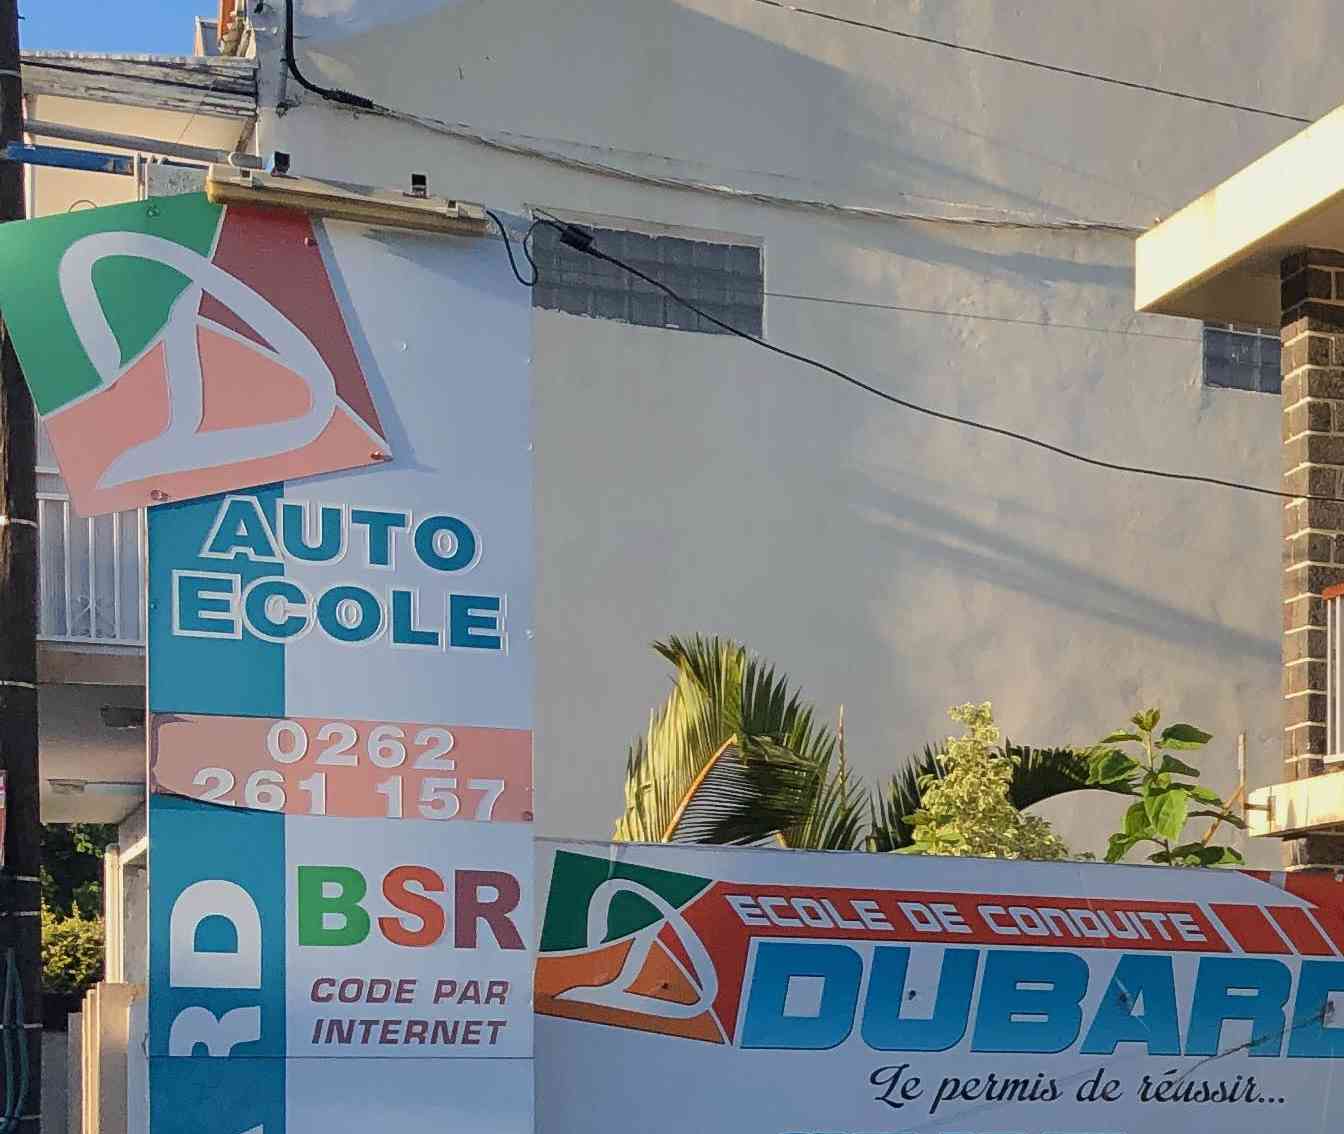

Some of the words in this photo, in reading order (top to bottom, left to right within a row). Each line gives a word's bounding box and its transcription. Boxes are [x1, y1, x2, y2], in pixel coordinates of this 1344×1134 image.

[199, 493, 482, 572] AUTO
[171, 569, 509, 655] ECOLE
[266, 721, 456, 770] 0262
[191, 766, 328, 817] 261
[377, 776, 506, 822] 157
[296, 864, 528, 951] BSR
[726, 895, 898, 932] ECOLE
[904, 903, 971, 935] DE
[989, 905, 1210, 943] CONDUITE
[310, 976, 419, 1006] CODE
[432, 978, 511, 1008] PAR
[311, 1018, 508, 1047] INTERNET
[869, 1063, 922, 1110] Le
[928, 1070, 1062, 1114] permis
[1076, 1066, 1122, 1102] de
[1137, 1069, 1286, 1106] réussir...
